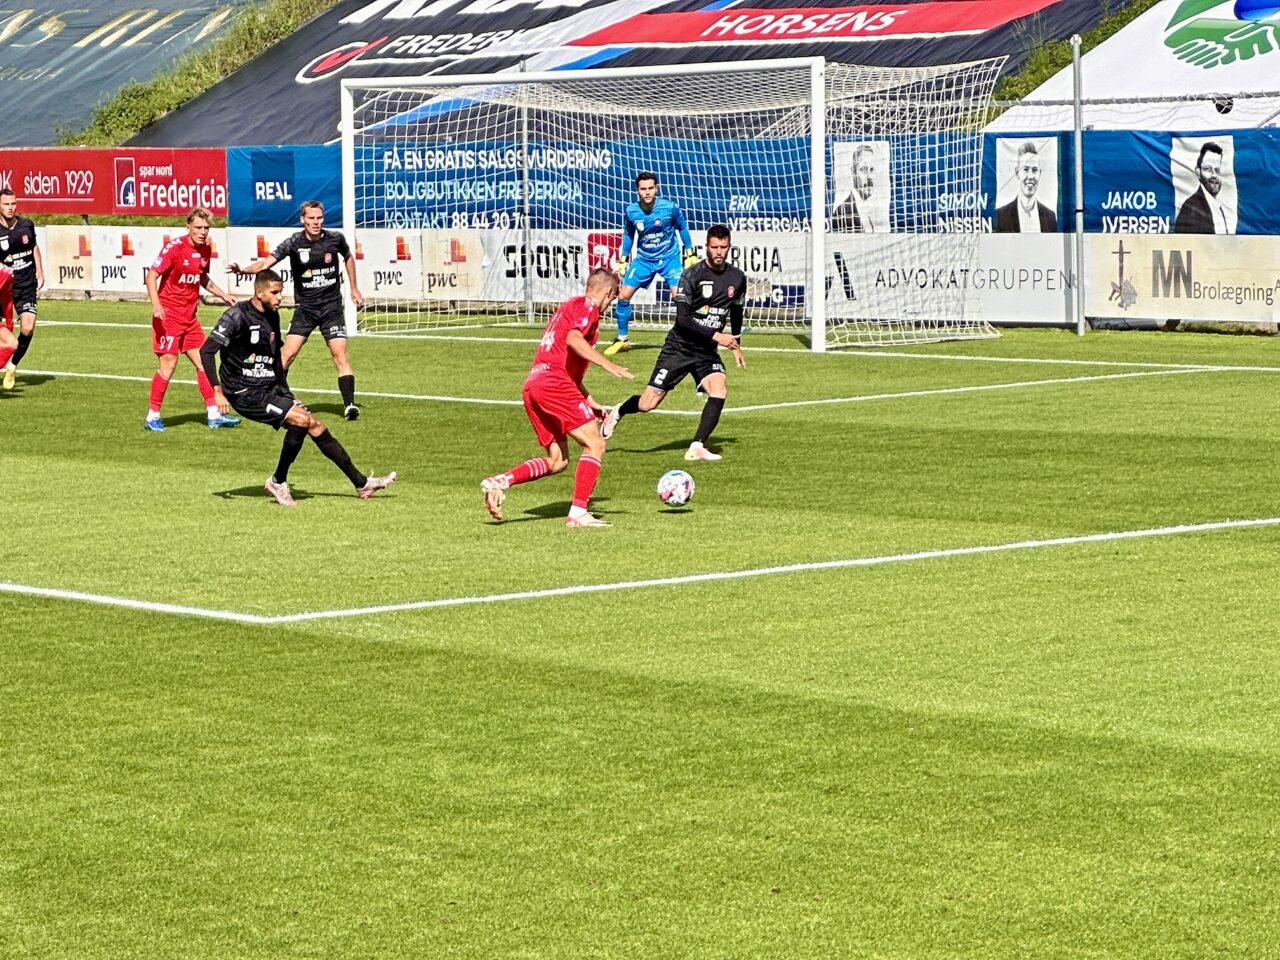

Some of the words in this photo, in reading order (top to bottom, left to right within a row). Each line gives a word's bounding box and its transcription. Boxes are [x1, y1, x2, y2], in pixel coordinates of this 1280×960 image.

[701, 9, 909, 37] HORSENS
[405, 150, 420, 169] EN
[425, 150, 473, 170] GRATIS
[24, 170, 60, 194] siden
[65, 170, 94, 194] 1929
[255, 181, 292, 200] REAL
[139, 178, 226, 208] Fredericia
[729, 194, 759, 211] ERIK
[938, 192, 988, 211] SIMON
[1102, 191, 1157, 210] JAKOB
[451, 211, 468, 230] 88
[492, 211, 510, 230] 20
[728, 216, 831, 233] VESTERGAAD
[939, 216, 992, 233] NISSEN
[1103, 215, 1170, 234] IVERSEN
[503, 244, 583, 279] SPORT
[59, 265, 84, 284] pwc
[101, 264, 127, 283] pwc
[373, 269, 403, 291] pwc
[427, 271, 457, 292] pwc
[875, 269, 1070, 291] ADVOKATGRUPPEN
[1193, 281, 1274, 305] Brolægning
[654, 368, 669, 386] 2
